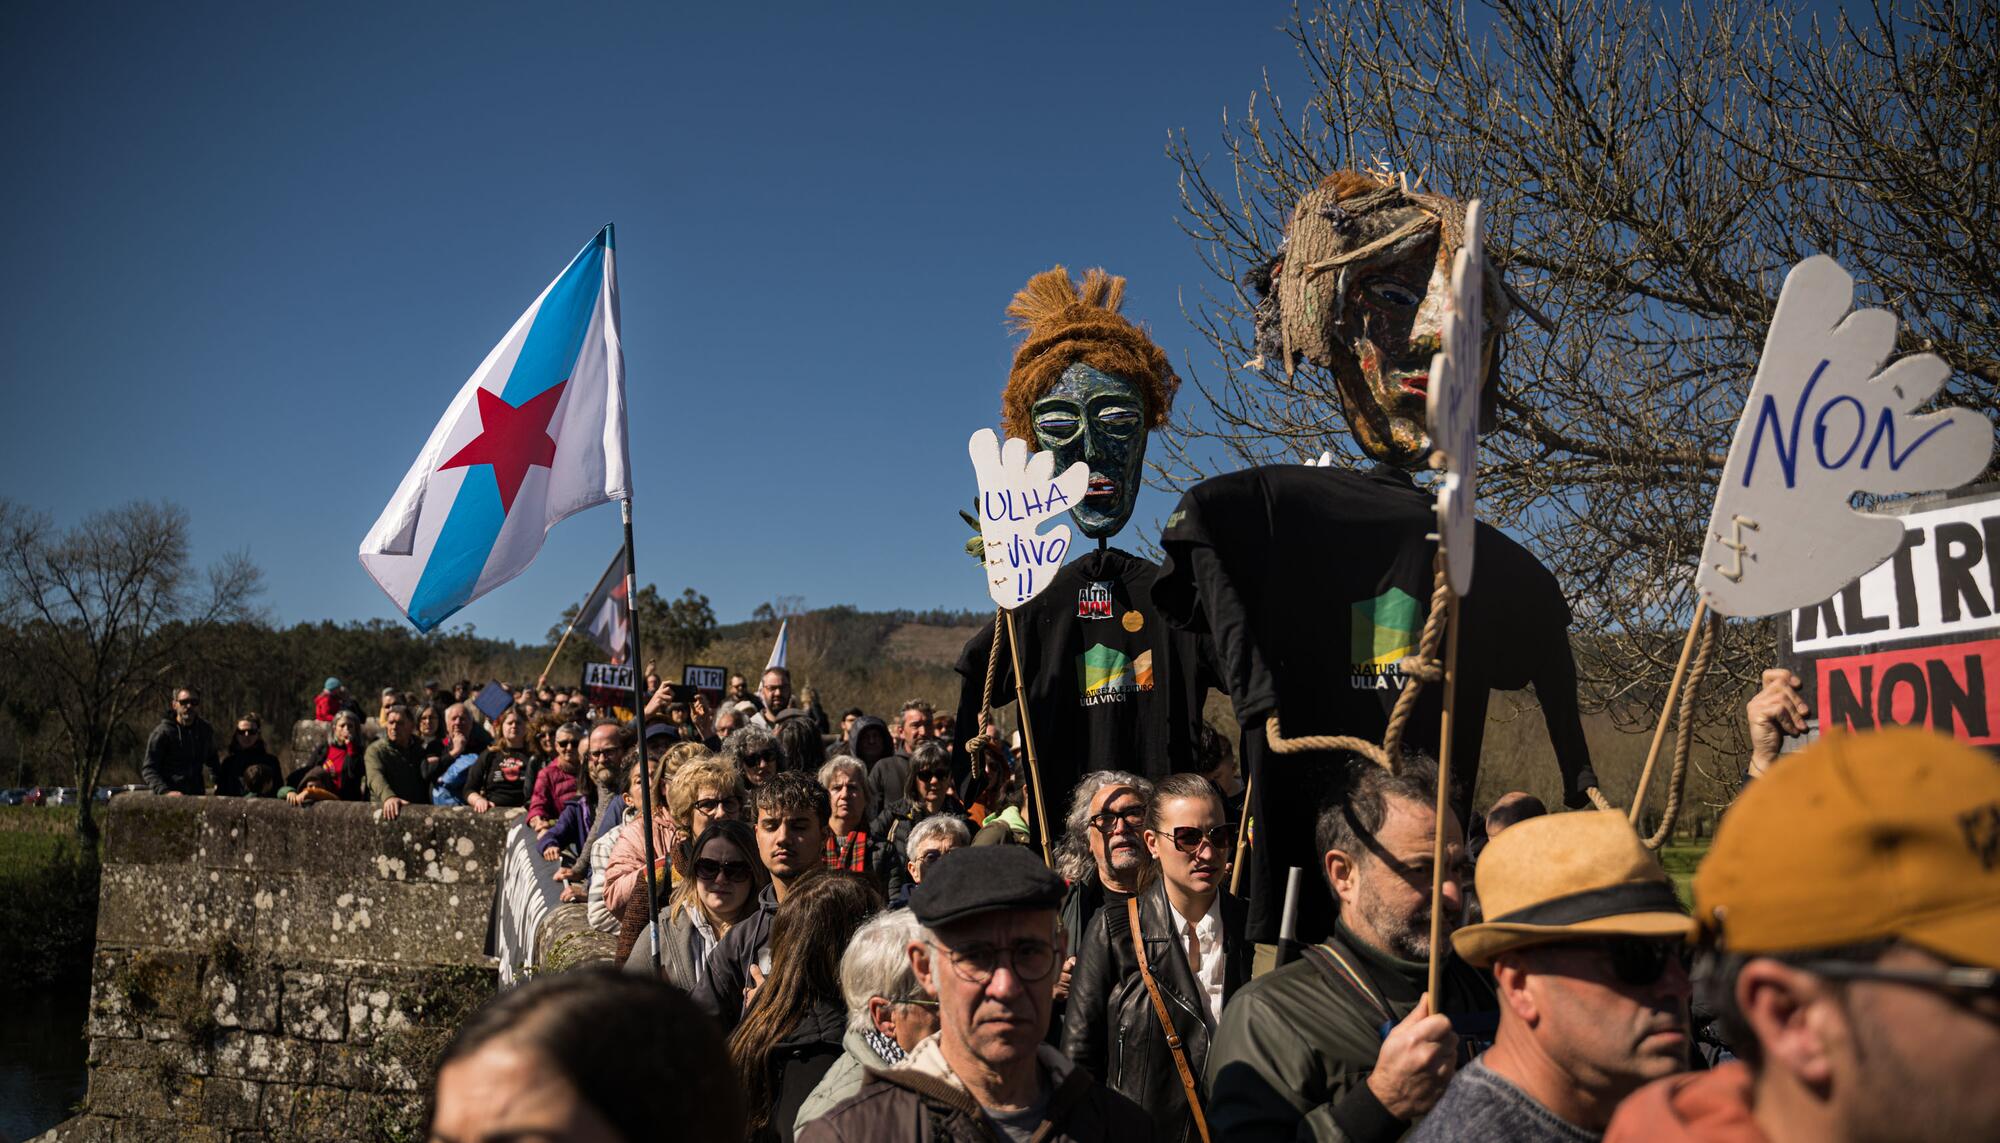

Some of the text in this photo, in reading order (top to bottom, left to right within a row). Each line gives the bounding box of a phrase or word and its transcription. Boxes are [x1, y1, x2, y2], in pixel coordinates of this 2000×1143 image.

[1742, 359, 1954, 488] NON
[986, 483, 1068, 521] ULHA
[1080, 585, 1112, 602] ALTRI
[1080, 601, 1111, 616] NON
[591, 664, 633, 687] ALTRI
[688, 669, 723, 690] ALTRI
[1351, 675, 1388, 690] ULLA
[1829, 654, 1990, 738] NON
